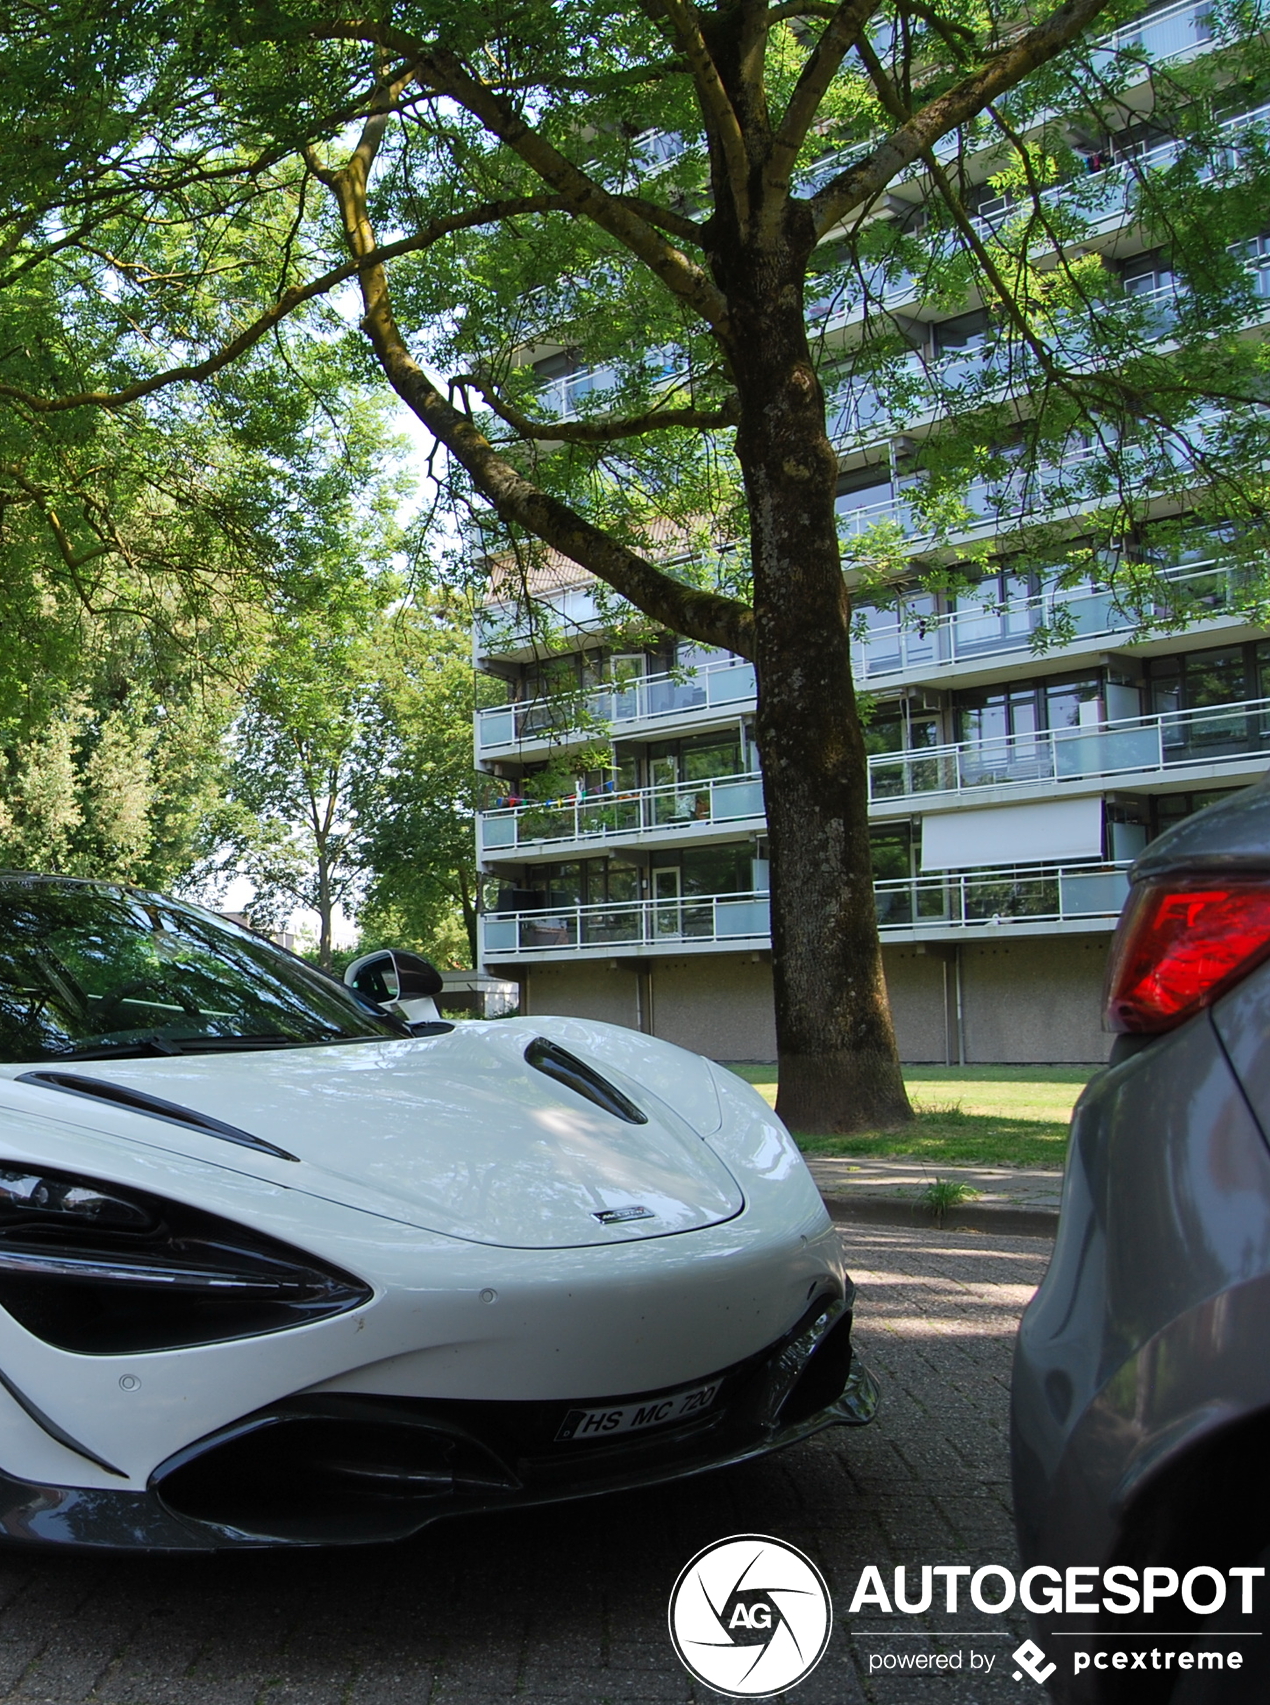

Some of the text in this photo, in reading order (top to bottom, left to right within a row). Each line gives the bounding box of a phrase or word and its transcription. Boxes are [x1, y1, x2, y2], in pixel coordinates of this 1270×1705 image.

[582, 1386, 716, 1433] HS MC 720
